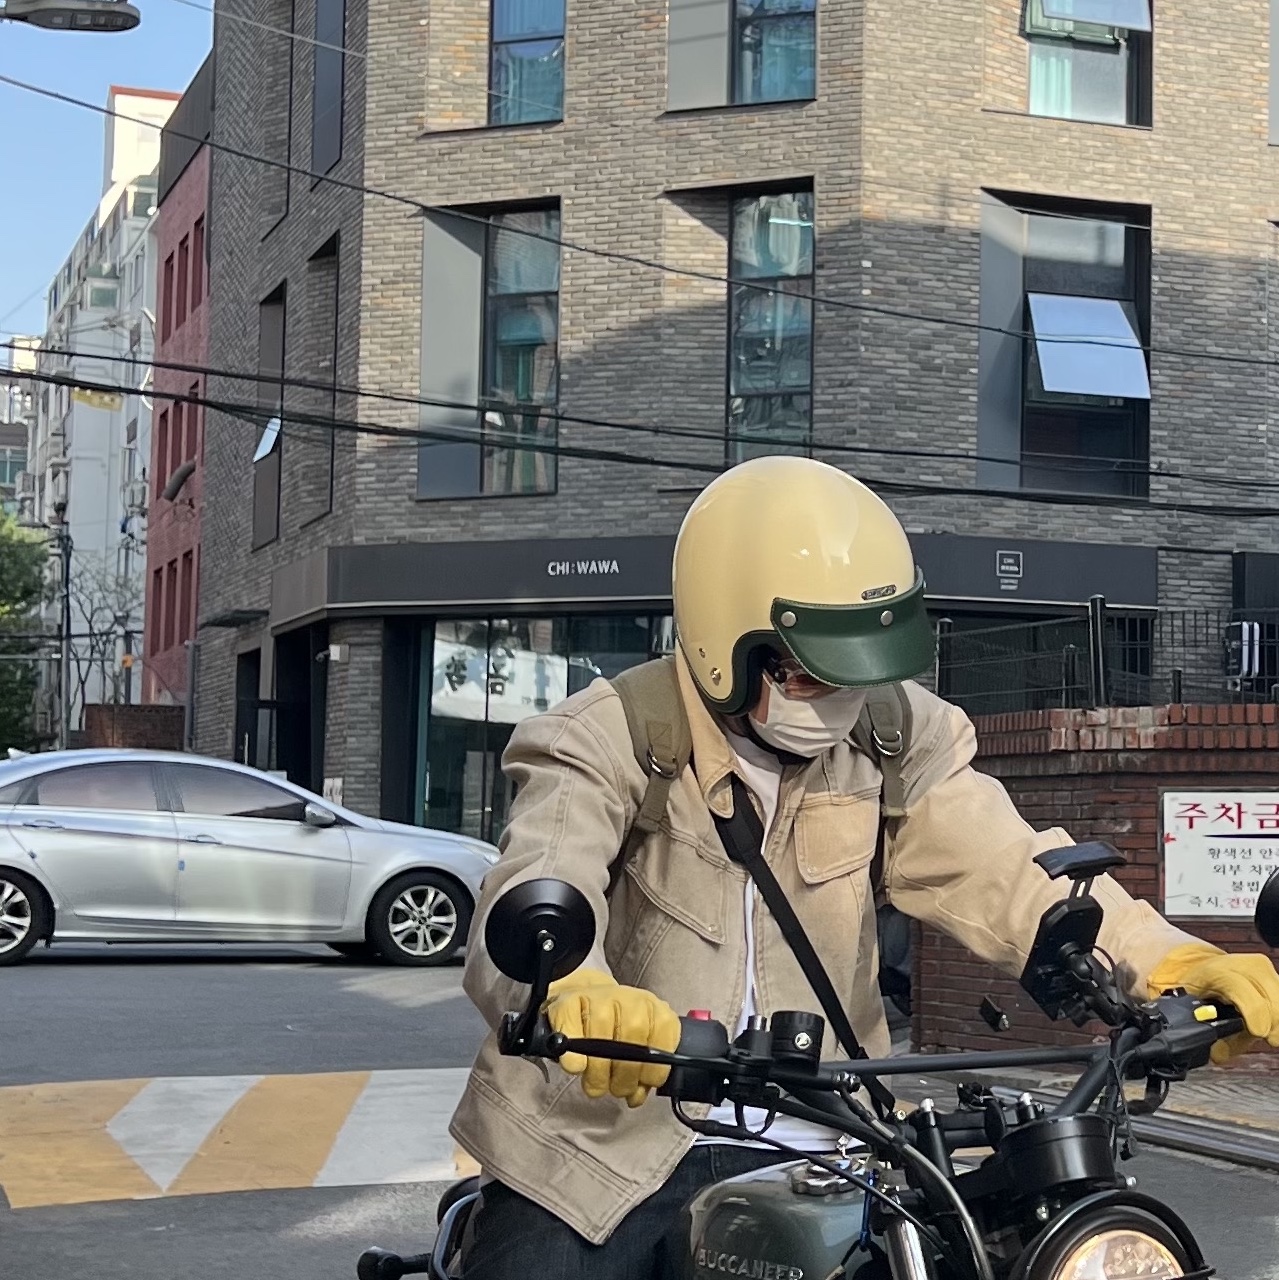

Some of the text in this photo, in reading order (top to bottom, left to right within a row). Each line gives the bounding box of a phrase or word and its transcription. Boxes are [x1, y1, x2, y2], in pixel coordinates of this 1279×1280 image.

[547, 559, 620, 576] CHI:WAWA
[1208, 847, 1252, 860] 황색선
[1213, 864, 1242, 876] 외부
[1232, 880, 1260, 892] 불법
